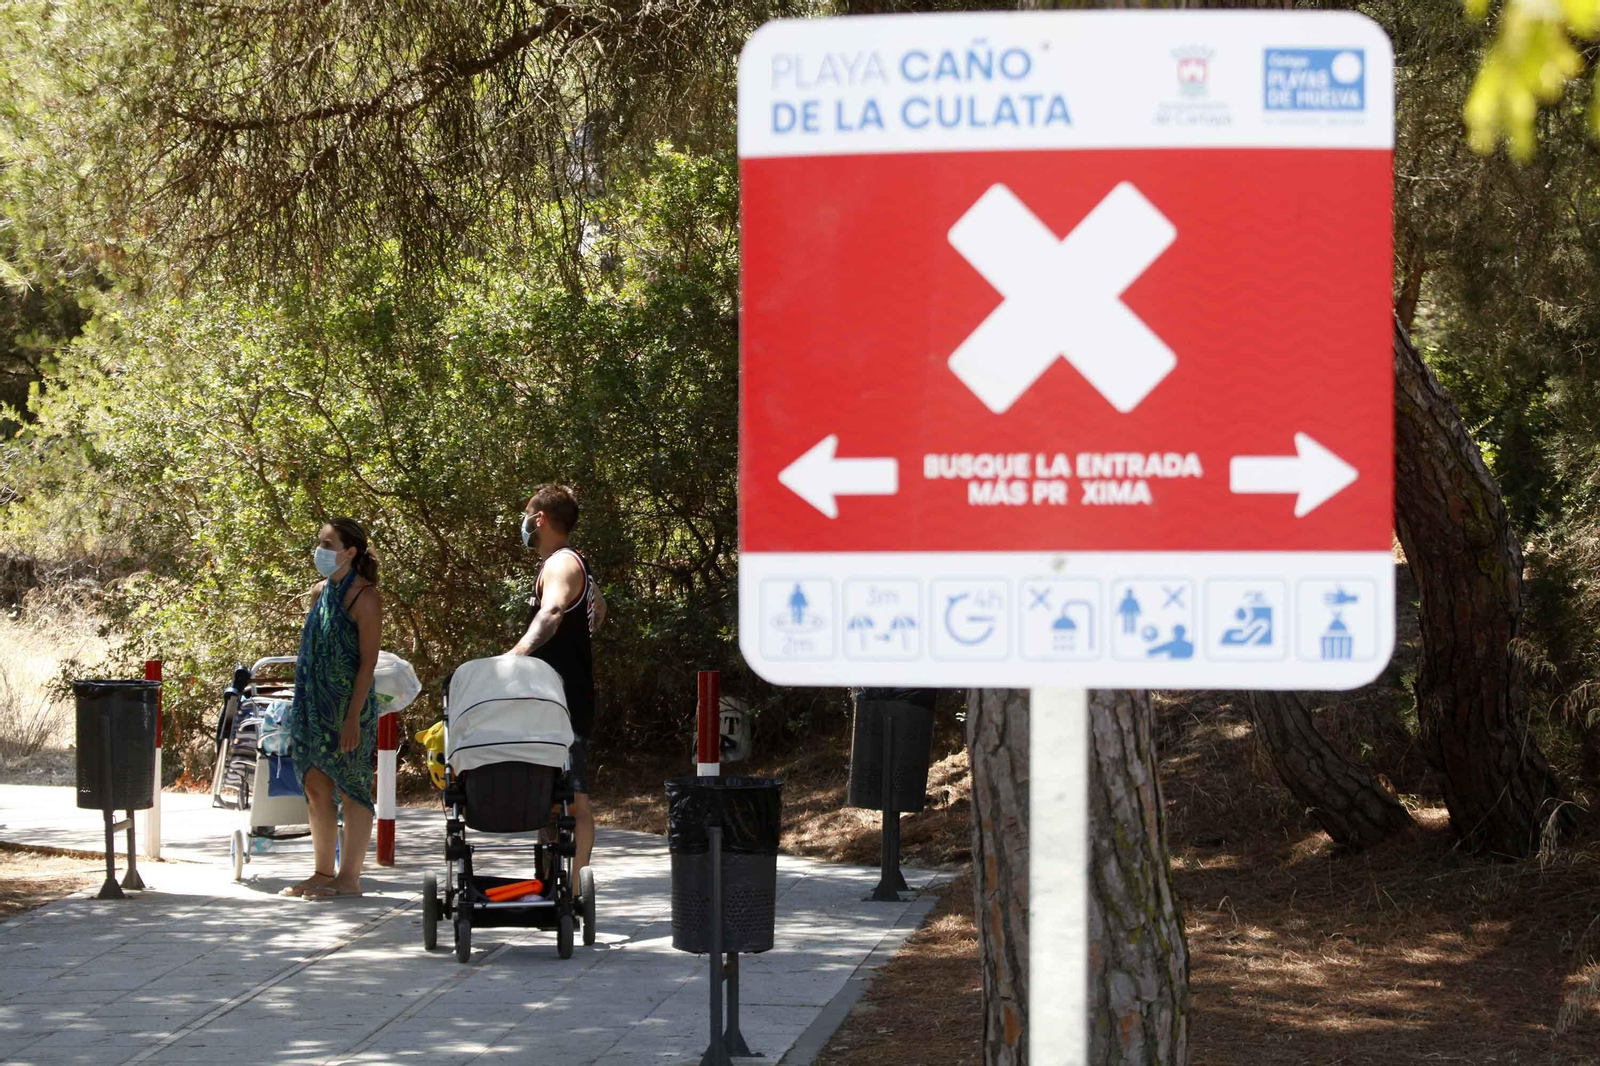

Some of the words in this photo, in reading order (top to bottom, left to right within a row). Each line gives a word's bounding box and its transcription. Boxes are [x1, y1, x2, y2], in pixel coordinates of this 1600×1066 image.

[771, 51, 888, 89] PLAYA
[900, 39, 1032, 83] CAÑO
[771, 100, 820, 134] DE
[836, 98, 885, 132] LA
[900, 95, 1072, 129] CULATA
[924, 453, 1031, 479] BUSQUE
[1035, 453, 1071, 478] LA
[1076, 452, 1202, 478] ENTRADA
[968, 477, 1028, 505] MÁS
